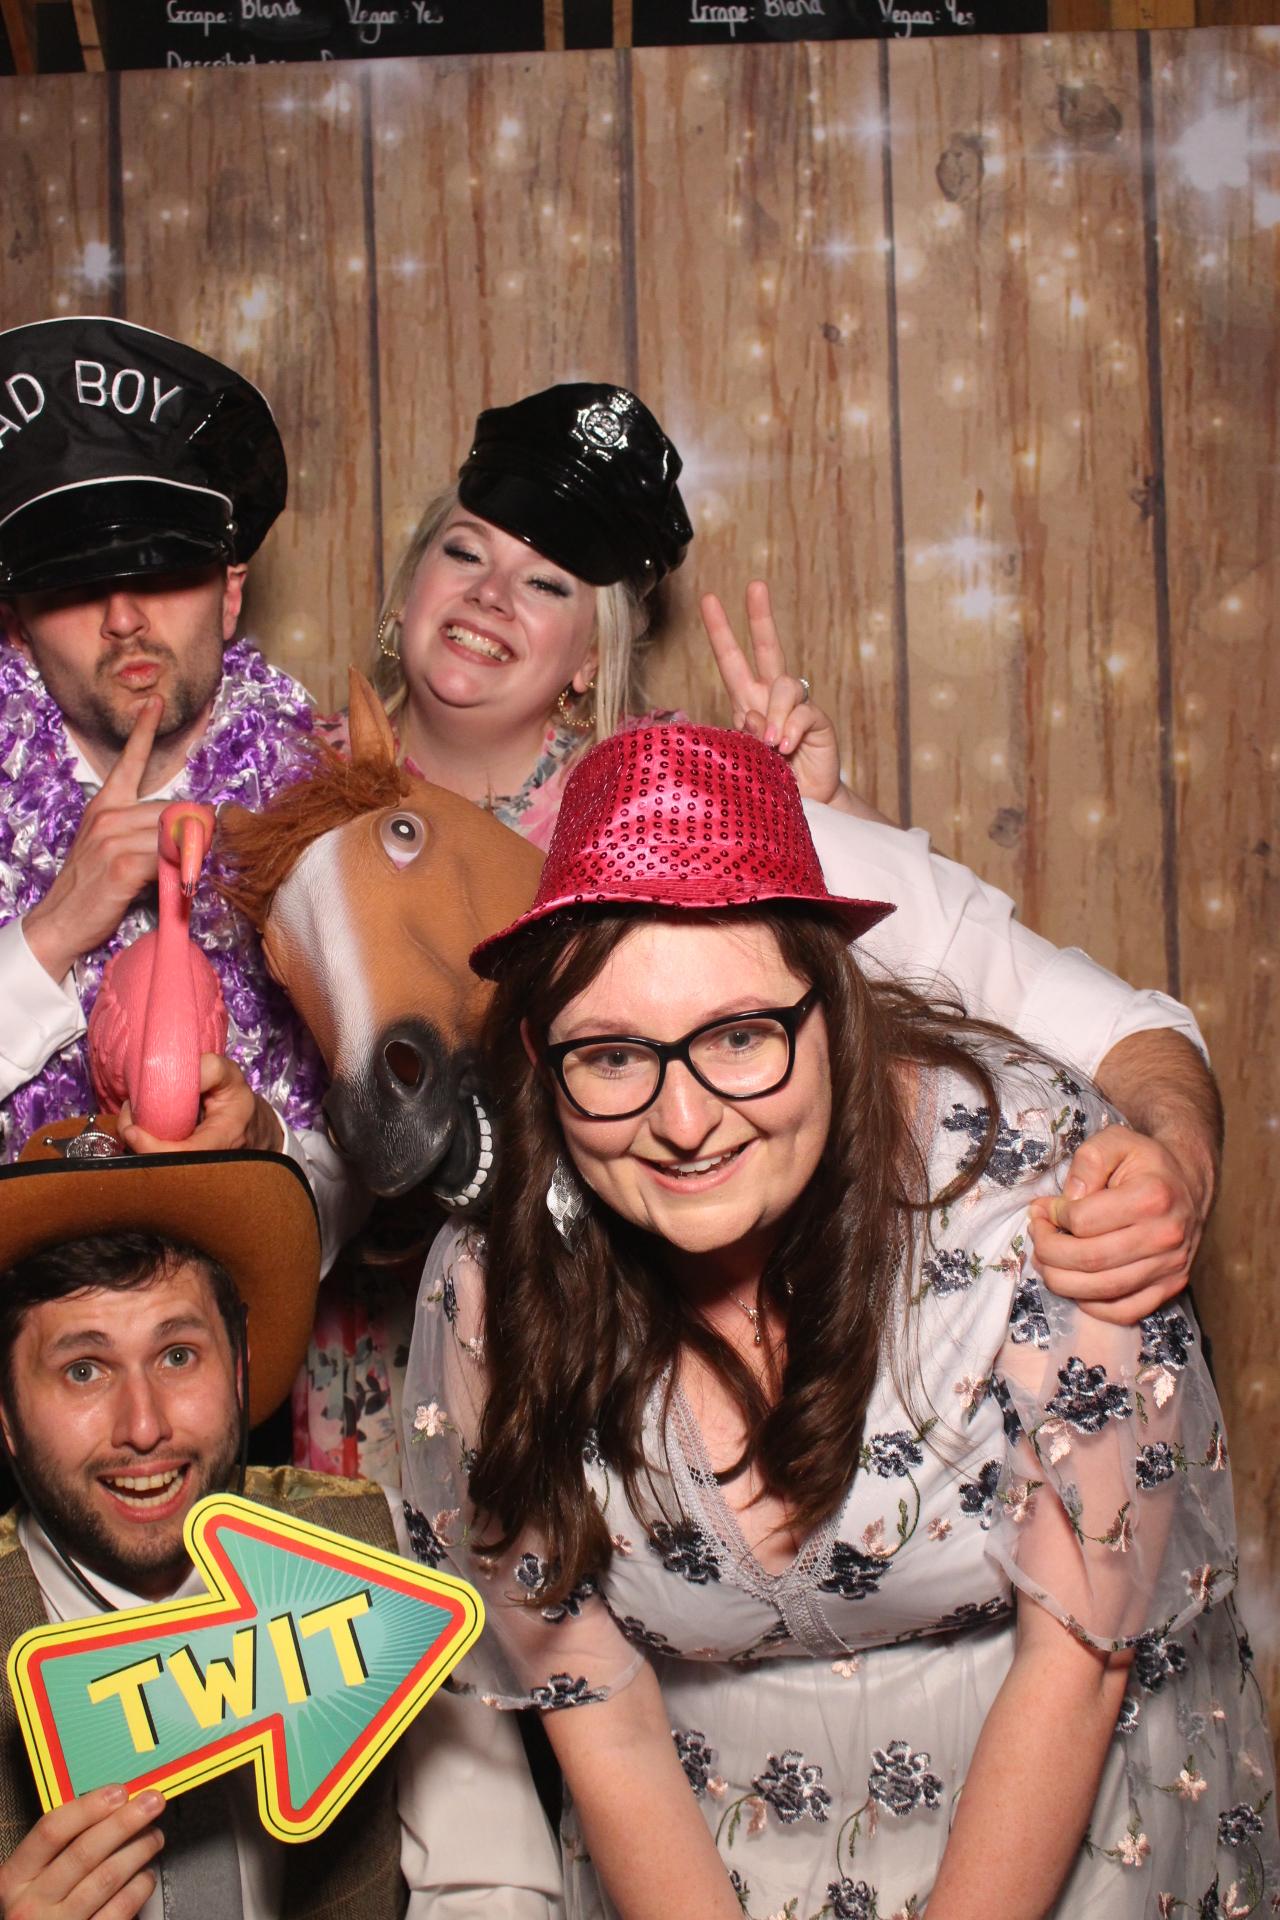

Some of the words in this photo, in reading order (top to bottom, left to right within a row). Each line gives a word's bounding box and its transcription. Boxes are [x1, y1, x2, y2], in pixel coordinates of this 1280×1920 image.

[167, 0, 233, 37] Grape:
[241, 0, 301, 19] Blend
[765, 0, 825, 17] Blend
[877, 0, 940, 39] Vegan:
[944, 0, 976, 26] Yes
[75, 360, 183, 424] BOY
[86, 1589, 373, 1754] TWIT
